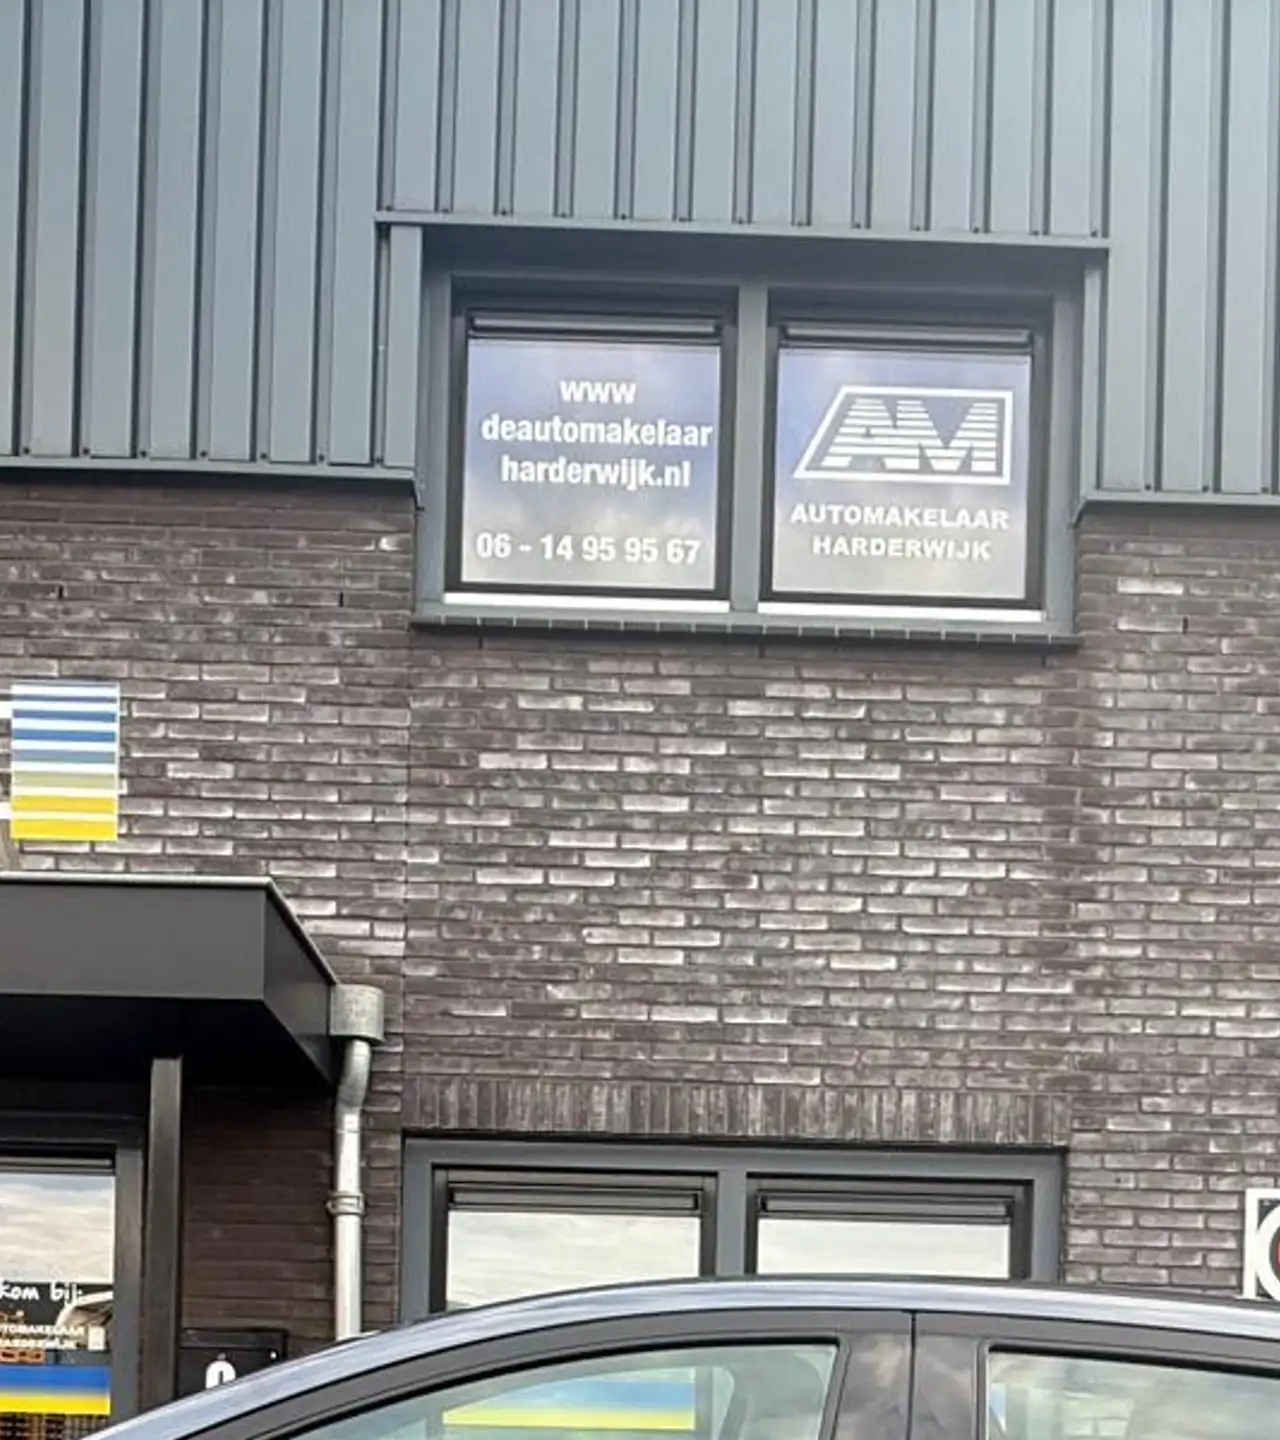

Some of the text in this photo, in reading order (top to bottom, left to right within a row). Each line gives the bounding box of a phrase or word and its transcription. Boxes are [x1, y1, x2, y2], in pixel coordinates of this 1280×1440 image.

[559, 379, 637, 403] www
[481, 415, 713, 449] deautomakelaar
[818, 397, 999, 473] AM
[500, 456, 691, 491] harderwijk.nl
[789, 503, 1010, 531] AUTOMAKELAAR
[476, 535, 512, 559] 06
[540, 536, 575, 560] 14
[581, 537, 617, 561] 95
[622, 538, 658, 562] 95
[665, 539, 701, 564] 67
[811, 536, 992, 562] HARDERWIJK
